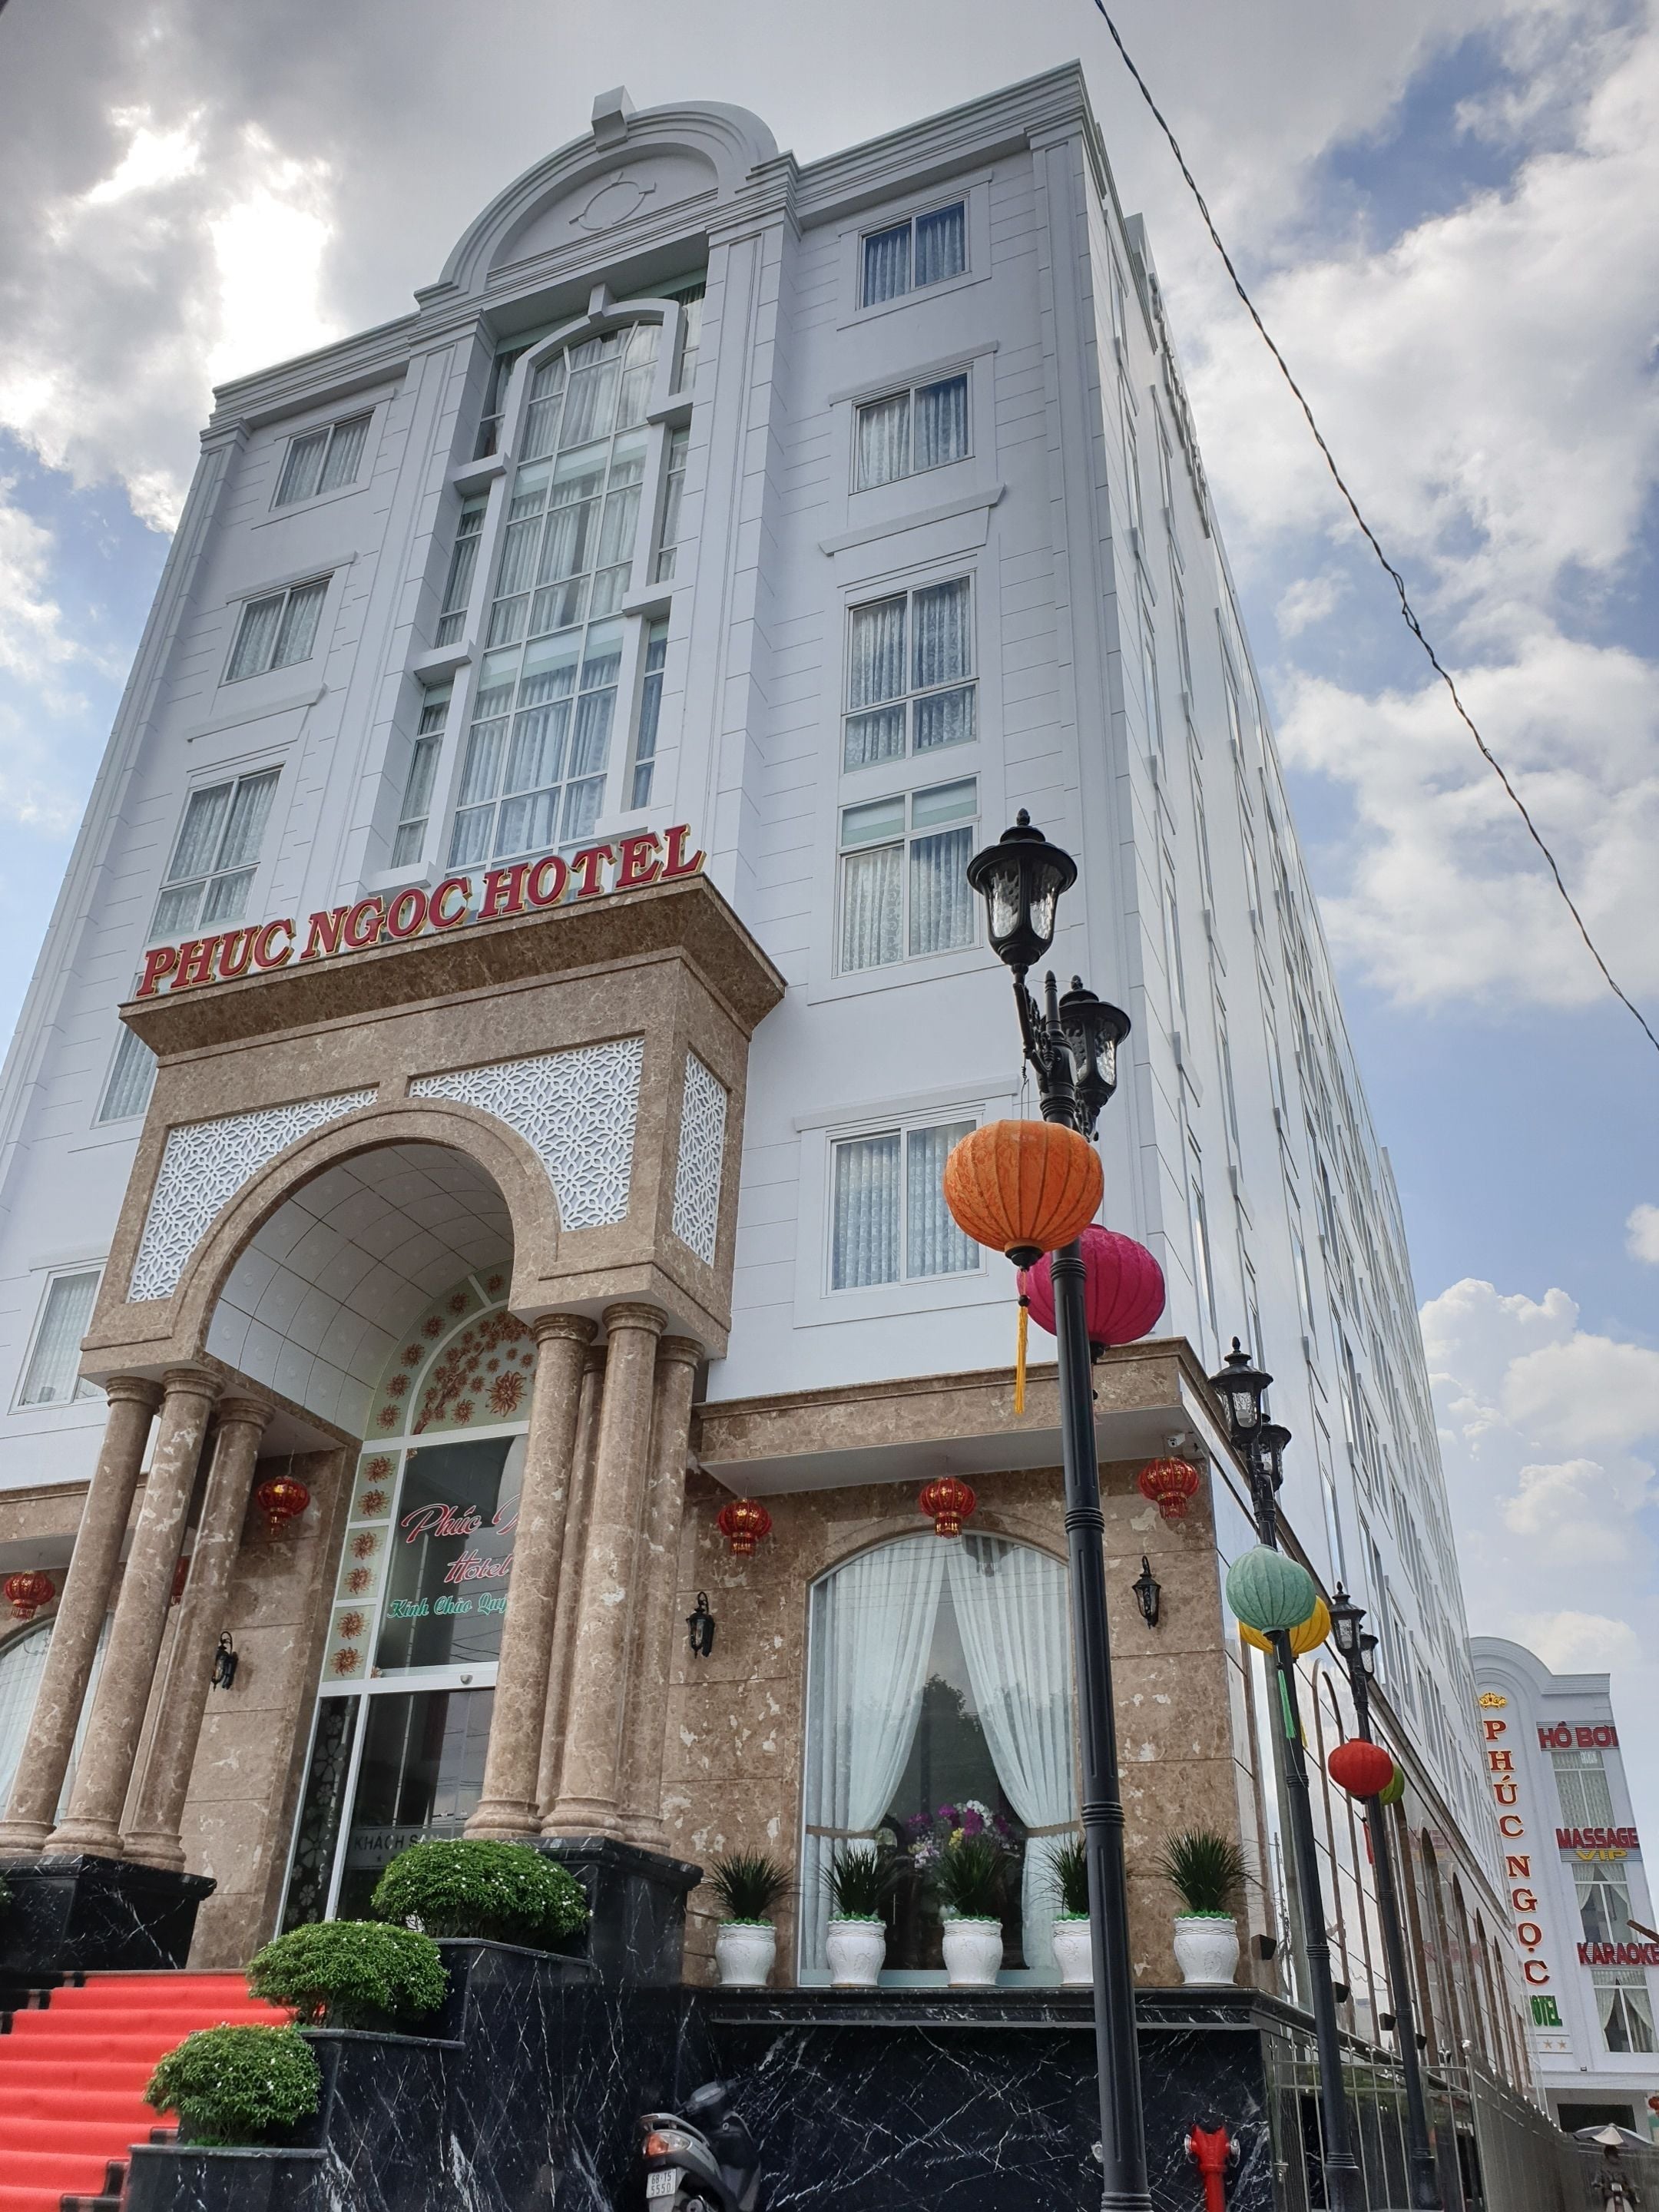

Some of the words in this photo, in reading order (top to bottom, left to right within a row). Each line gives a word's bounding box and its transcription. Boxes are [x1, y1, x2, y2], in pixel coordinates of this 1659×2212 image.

[135, 917, 297, 998] PHUC
[300, 876, 473, 960] NGOC
[475, 823, 707, 922] HOTEL
[401, 1503, 482, 1544] Phúc
[443, 1548, 515, 1584] Hotel
[353, 1830, 405, 1850] KHÁCH
[1483, 1720, 1525, 1839] PHÚC
[1505, 1855, 1551, 1986] NGỌC
[1555, 1827, 1641, 1849] MASSAGE
[1575, 1848, 1628, 1862] VIP
